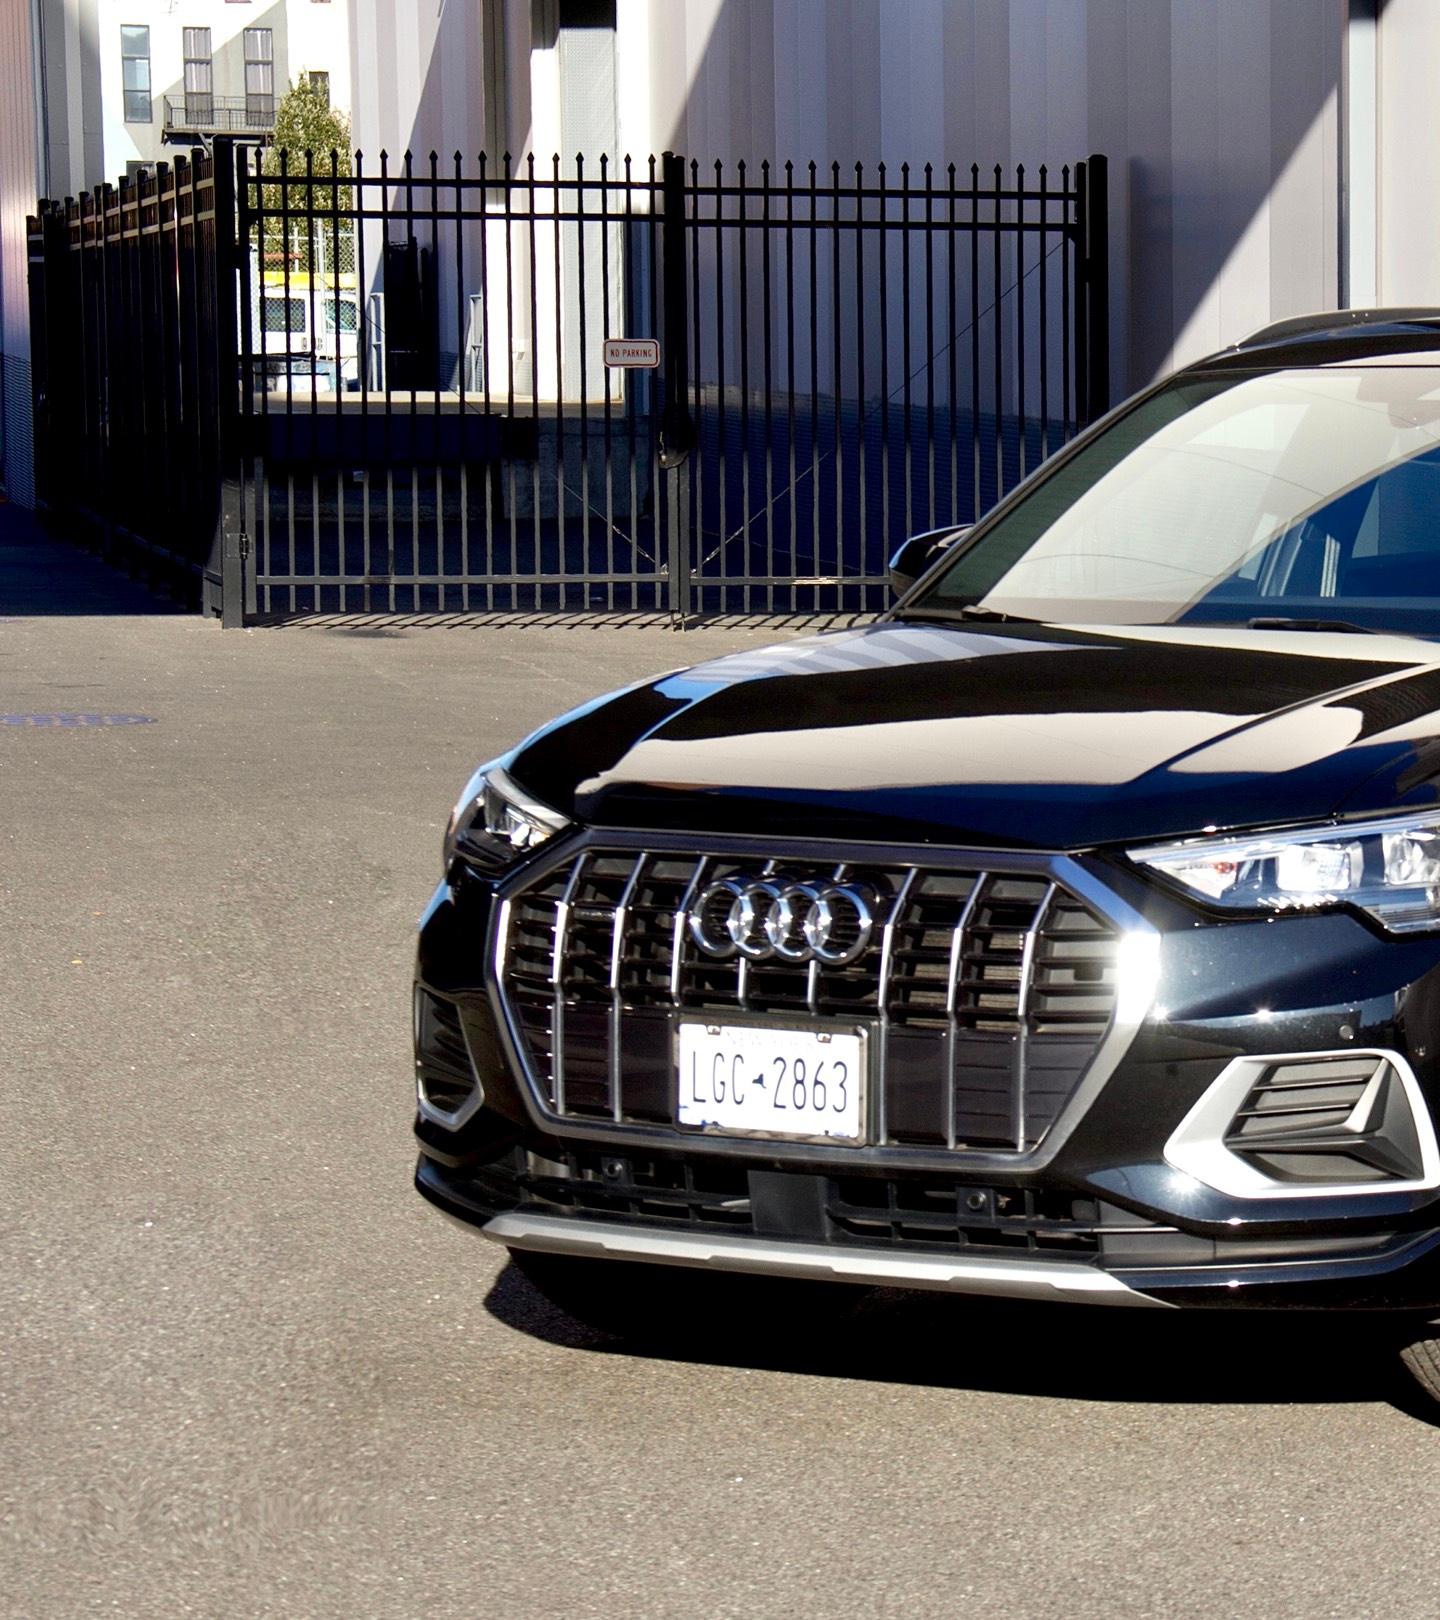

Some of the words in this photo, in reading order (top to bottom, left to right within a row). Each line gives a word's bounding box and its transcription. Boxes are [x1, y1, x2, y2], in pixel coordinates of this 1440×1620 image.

[610, 349, 620, 358] NO
[622, 348, 652, 358] PARKING
[692, 1050, 745, 1105] LGC
[772, 1056, 848, 1113] 2863
